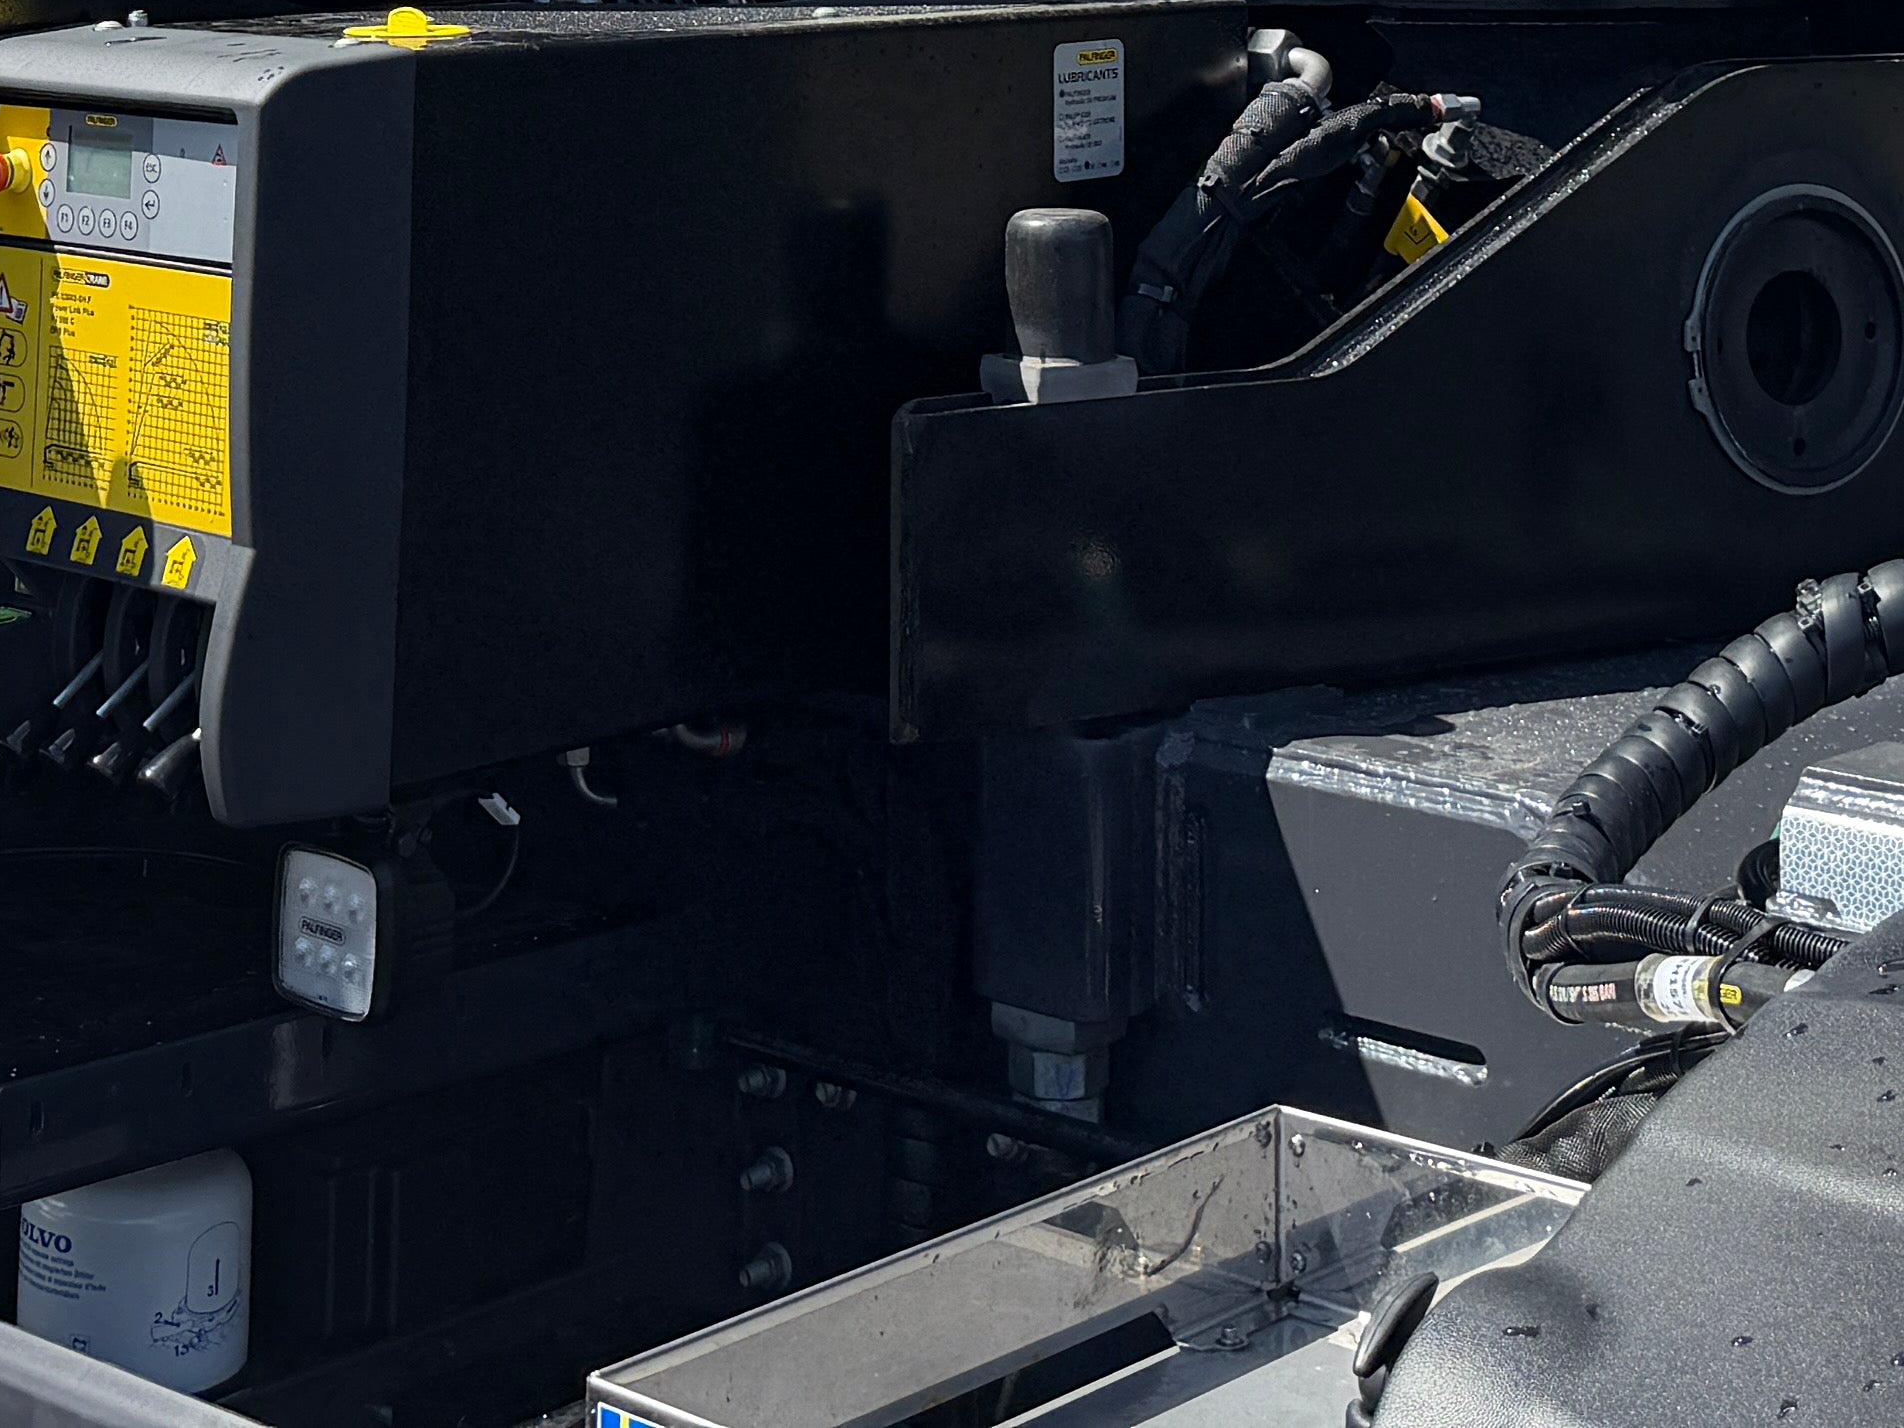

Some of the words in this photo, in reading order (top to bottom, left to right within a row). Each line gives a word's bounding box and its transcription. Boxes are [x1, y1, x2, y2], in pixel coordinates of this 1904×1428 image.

[1058, 68, 1119, 84] LUBRICANTS
[61, 213, 69, 224] F1
[82, 215, 90, 226] F2
[103, 218, 111, 229] F3
[124, 221, 133, 231] F4
[301, 919, 344, 942] PALFINGER
[21, 1216, 73, 1254] OLVO
